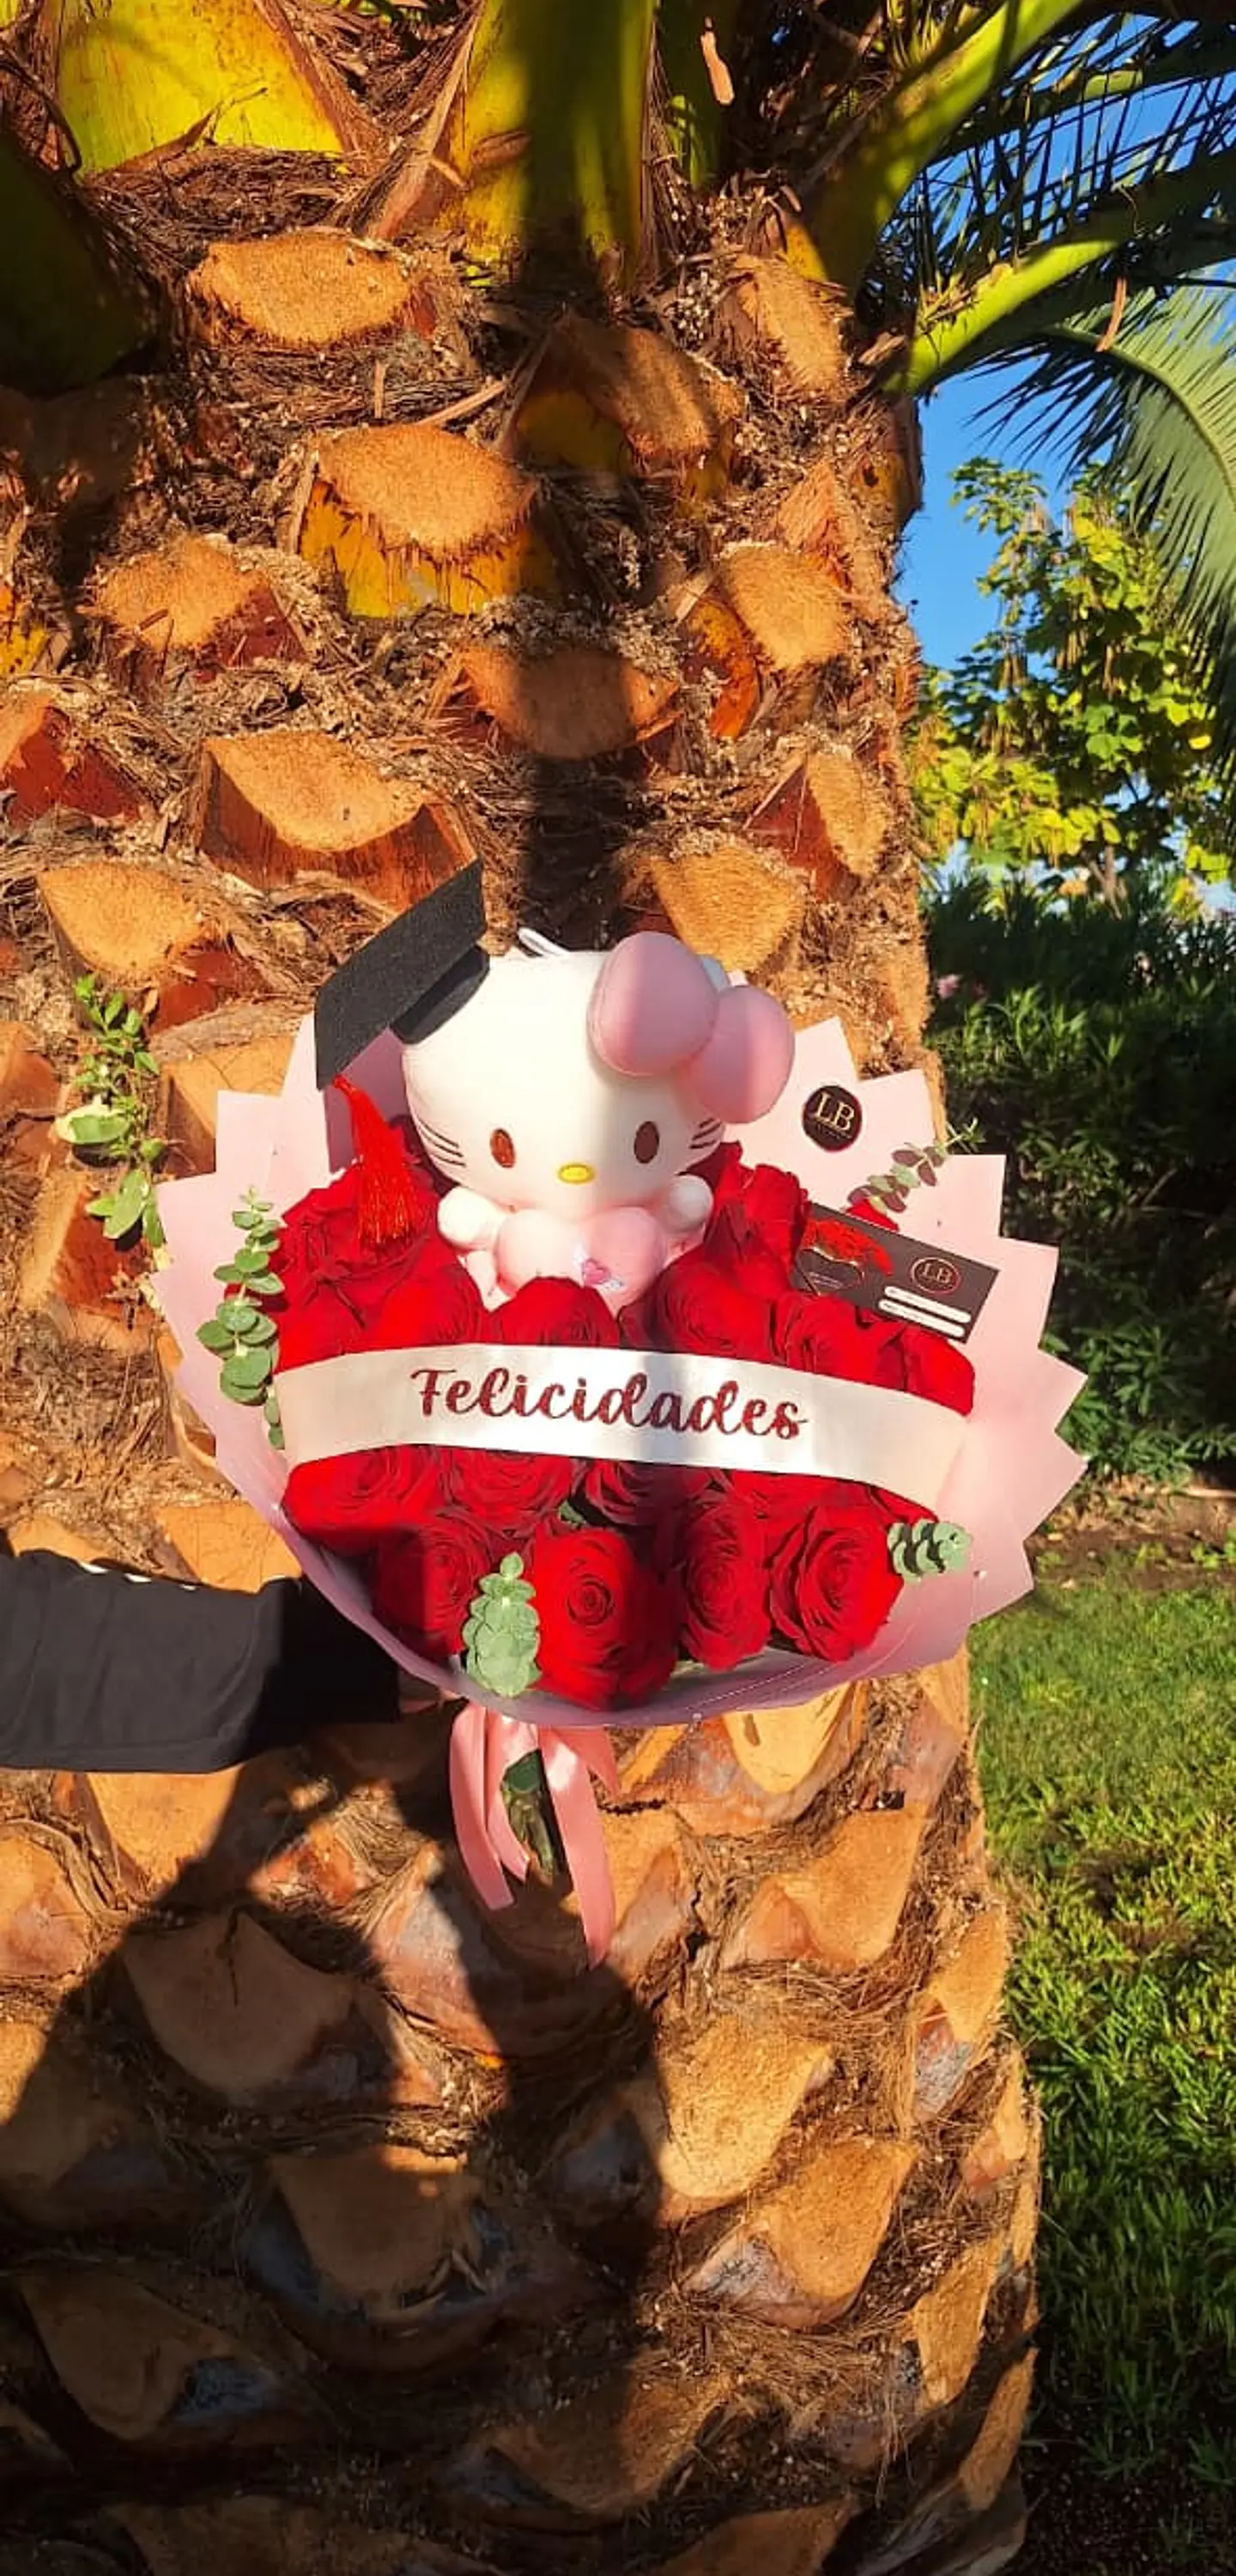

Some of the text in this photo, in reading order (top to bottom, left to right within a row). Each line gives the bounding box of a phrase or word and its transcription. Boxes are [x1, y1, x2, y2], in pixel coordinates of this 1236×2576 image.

[815, 1091, 855, 1131] LB
[921, 1262, 954, 1284] LB
[411, 1367, 808, 1440] Felicidades
